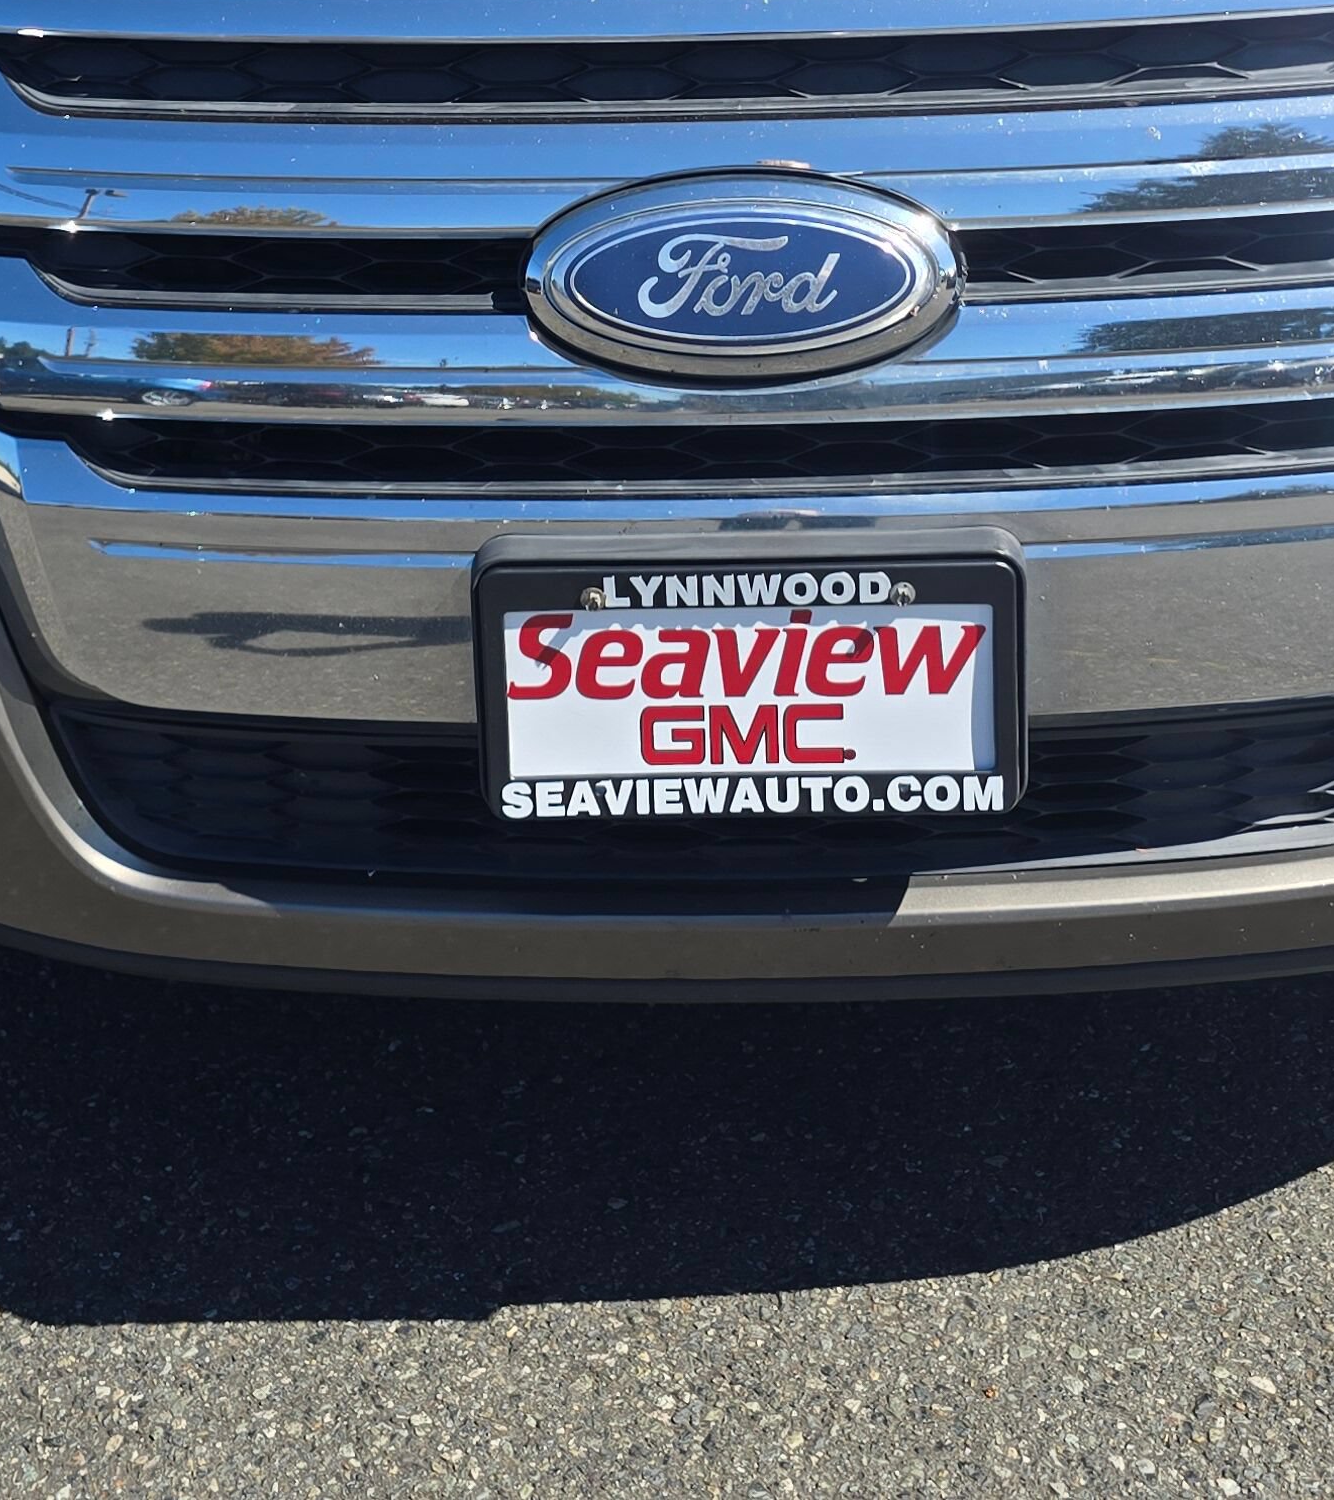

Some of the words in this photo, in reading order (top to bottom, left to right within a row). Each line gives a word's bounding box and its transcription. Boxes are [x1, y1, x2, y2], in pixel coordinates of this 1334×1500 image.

[637, 233, 841, 318] Ford
[601, 572, 892, 608] LYNNWOOD
[507, 609, 987, 700] Seaview
[640, 703, 845, 766] GMC
[501, 774, 1005, 820] SEAVIEWAUTO.COM
